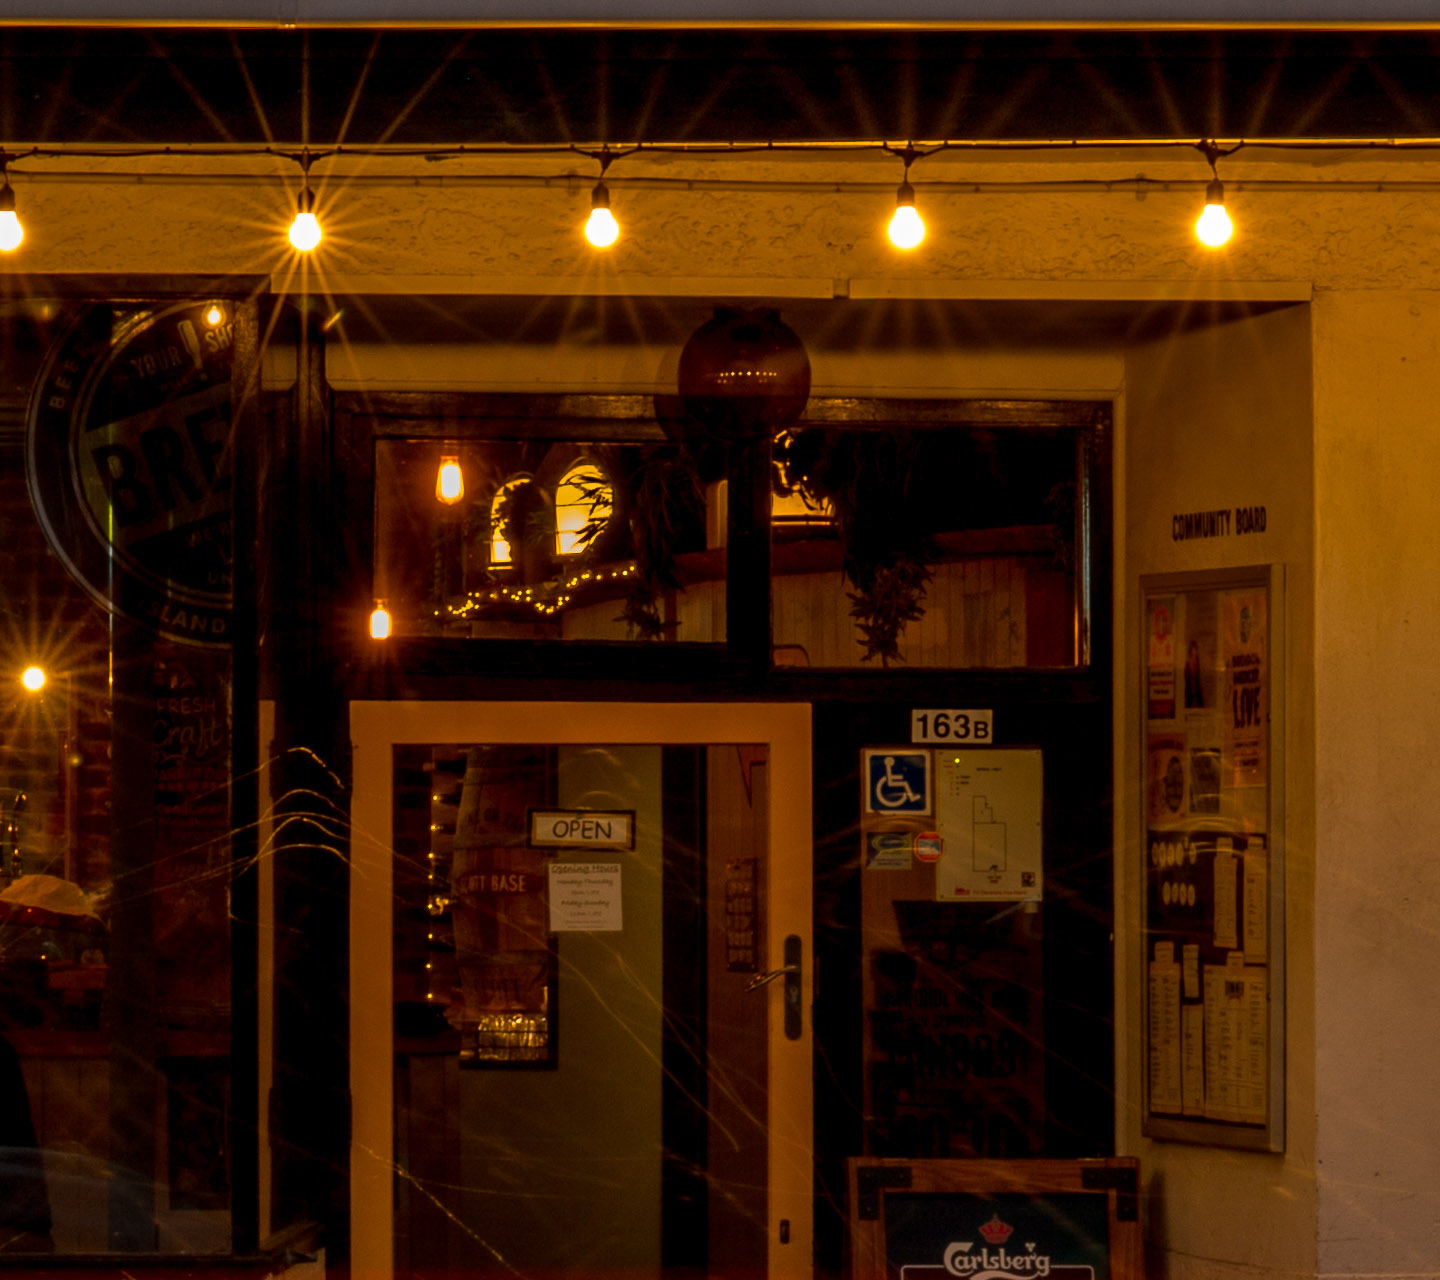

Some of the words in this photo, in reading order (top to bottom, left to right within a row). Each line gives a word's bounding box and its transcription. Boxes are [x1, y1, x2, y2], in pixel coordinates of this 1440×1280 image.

[1172, 508, 1232, 541] COMMUNITY
[1236, 506, 1267, 535] BOARD
[916, 713, 989, 739] 163B
[552, 819, 613, 840] OPEN
[490, 873, 527, 894] BASE
[943, 1241, 1051, 1280] Carlsberg
